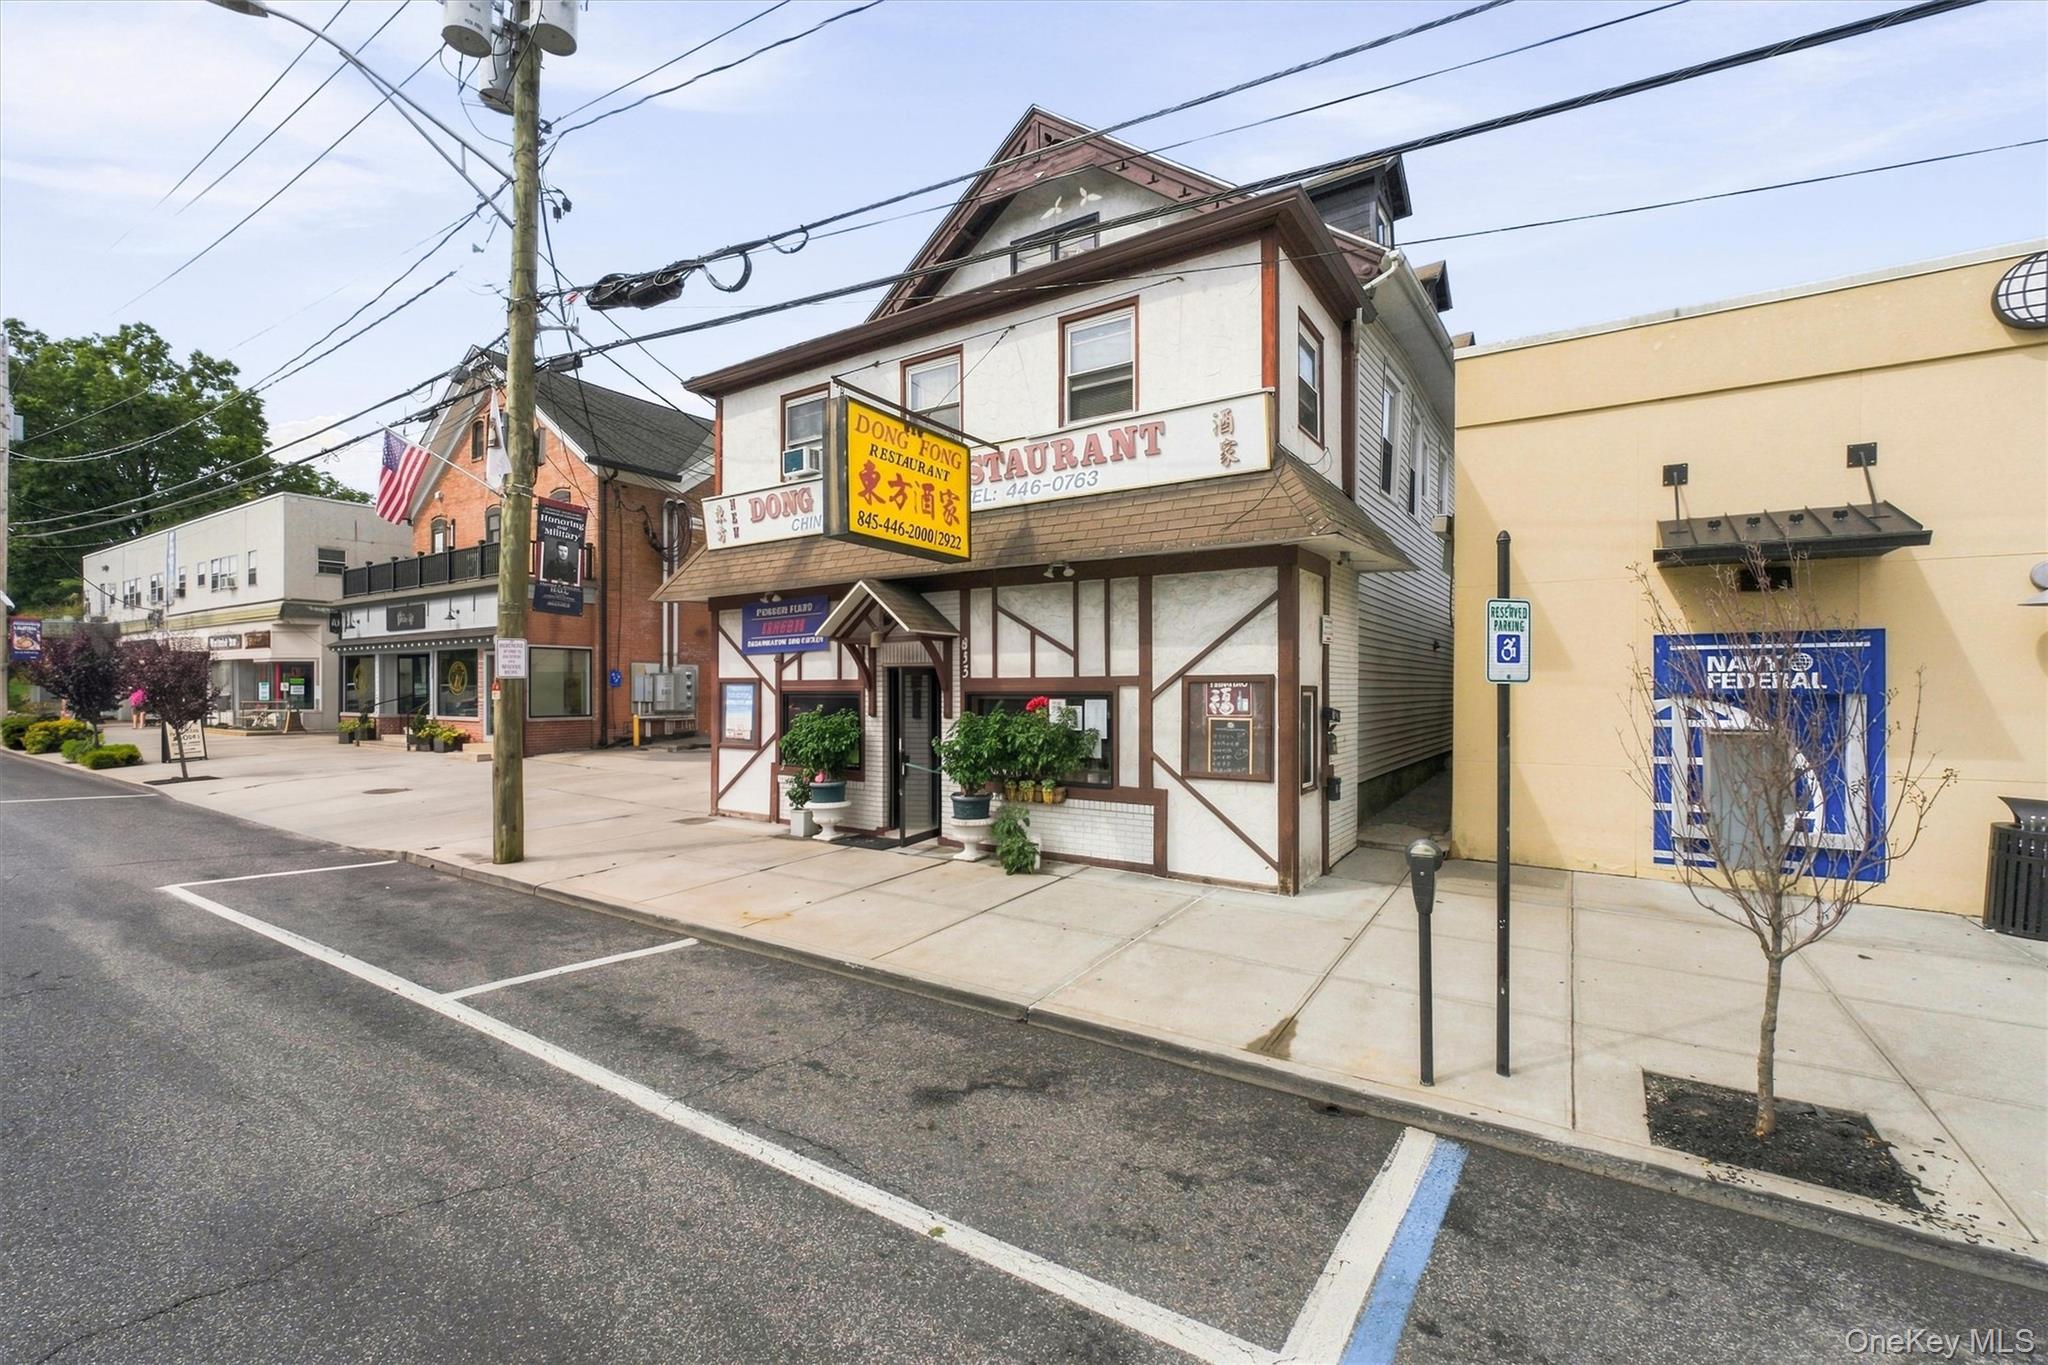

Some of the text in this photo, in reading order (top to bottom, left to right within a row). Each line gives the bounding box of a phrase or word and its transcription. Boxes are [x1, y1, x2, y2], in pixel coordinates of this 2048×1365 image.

[855, 414, 962, 470] DONG FONG
[869, 443, 951, 482] RESTAURANT
[858, 460, 960, 527] 東方酒家
[971, 470, 1099, 504] EL: 446-0763
[749, 487, 814, 524] DONG
[540, 513, 585, 531] Honoring
[544, 528, 580, 541] Military
[1490, 606, 1527, 619] RESERVED
[1494, 620, 1525, 632] PARKING
[1707, 655, 1784, 672] NAVY
[1707, 672, 1828, 689] FEDERAL
